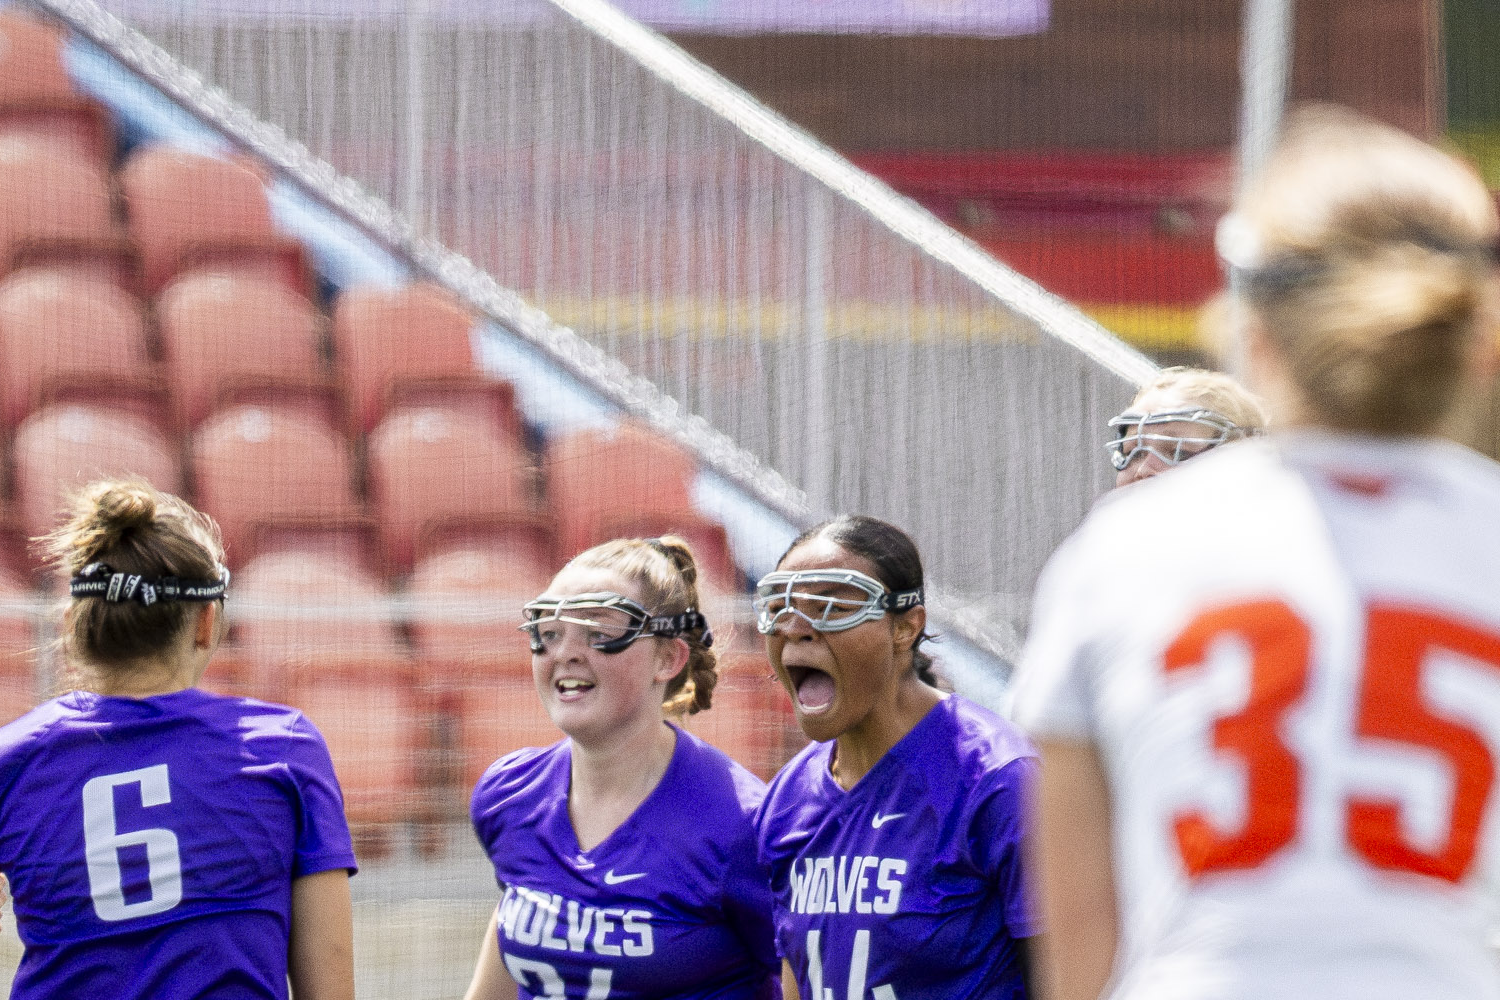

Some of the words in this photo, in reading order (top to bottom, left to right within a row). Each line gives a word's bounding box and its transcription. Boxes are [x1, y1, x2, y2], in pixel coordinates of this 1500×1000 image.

[897, 589, 921, 608] STX
[1161, 598, 1500, 884] 35
[82, 763, 183, 922] 6
[790, 855, 907, 915] WOLVES
[497, 887, 654, 957] WOLVES
